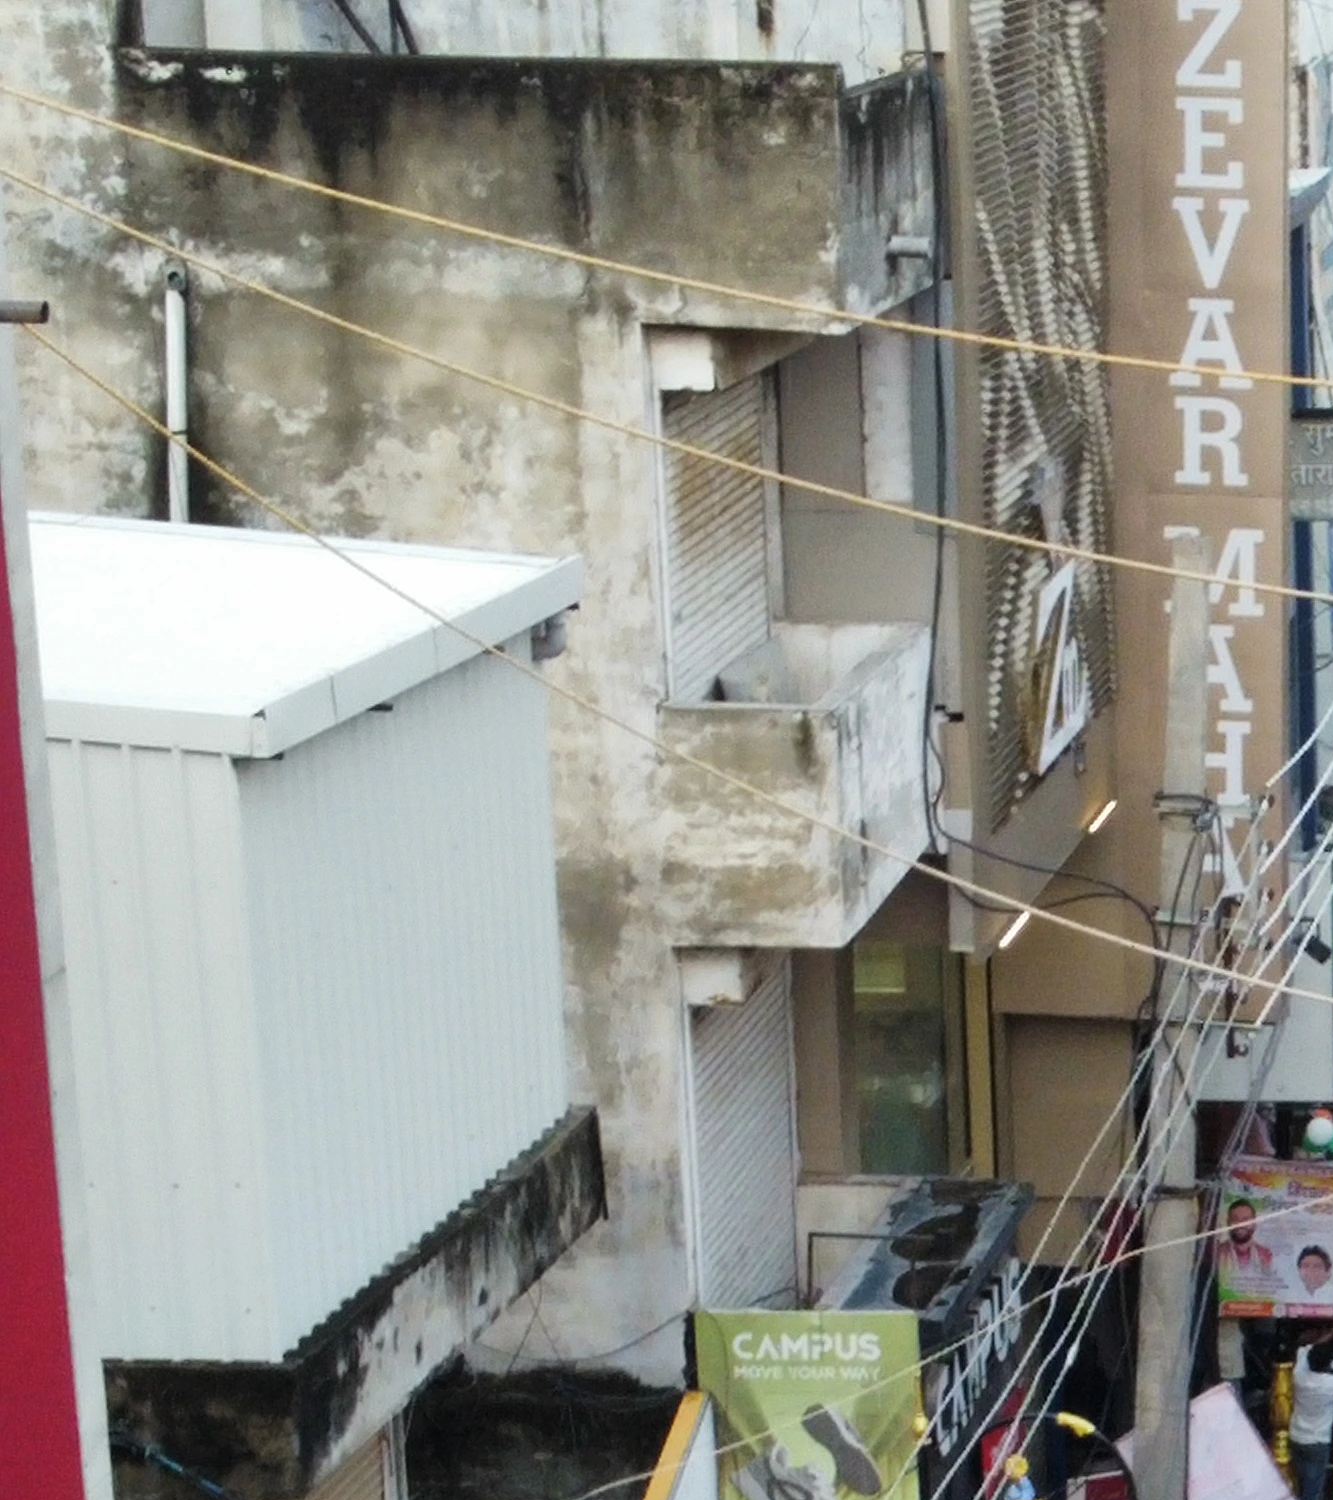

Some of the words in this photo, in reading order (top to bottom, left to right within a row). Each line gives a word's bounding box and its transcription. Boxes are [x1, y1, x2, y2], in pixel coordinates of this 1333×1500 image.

[1168, 0, 1253, 488] ZEVAR
[732, 1331, 882, 1362] CAMPUS
[734, 1364, 784, 1381] MOVE
[788, 1364, 835, 1381] YOUR
[839, 1364, 882, 1381] WAY
